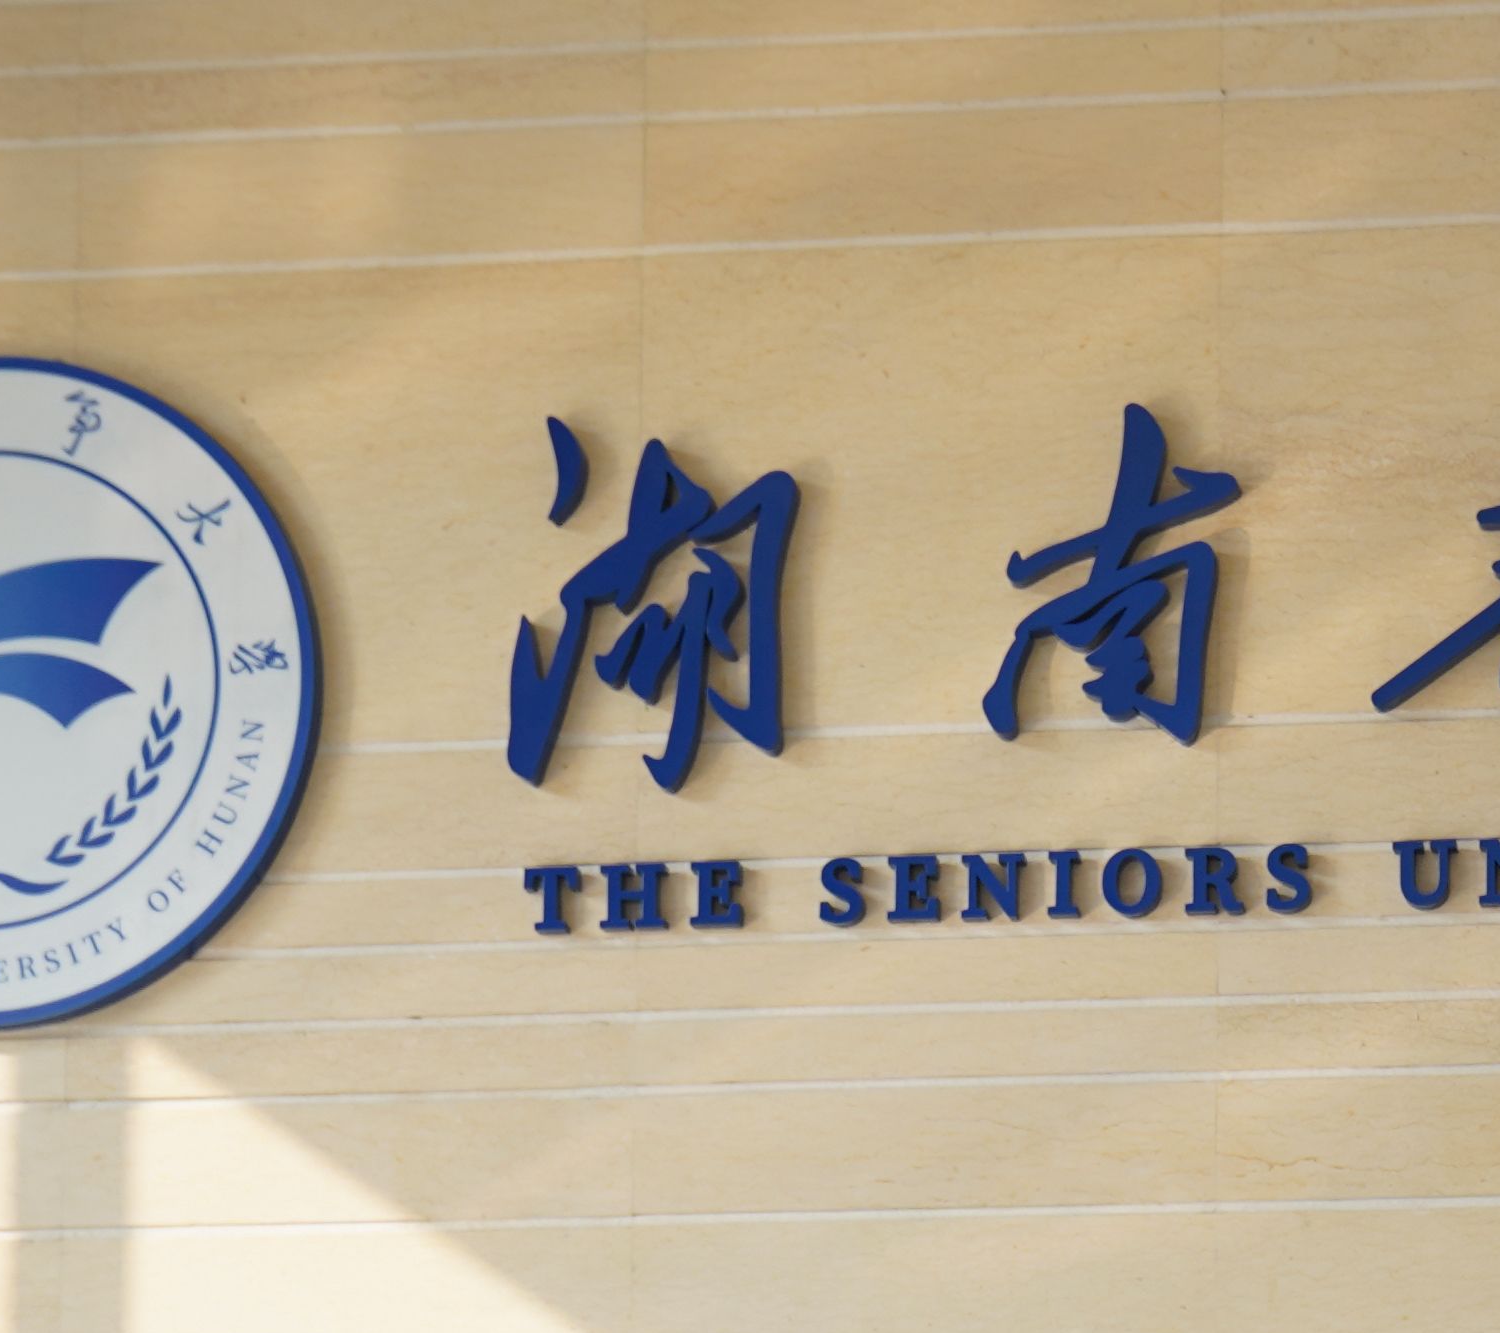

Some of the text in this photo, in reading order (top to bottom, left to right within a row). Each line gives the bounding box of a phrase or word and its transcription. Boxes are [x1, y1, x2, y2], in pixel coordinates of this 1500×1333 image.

[147, 870, 190, 913] OF
[194, 718, 265, 857] HUNAN
[523, 861, 744, 934] THE
[819, 843, 1312, 927] SENIORS
